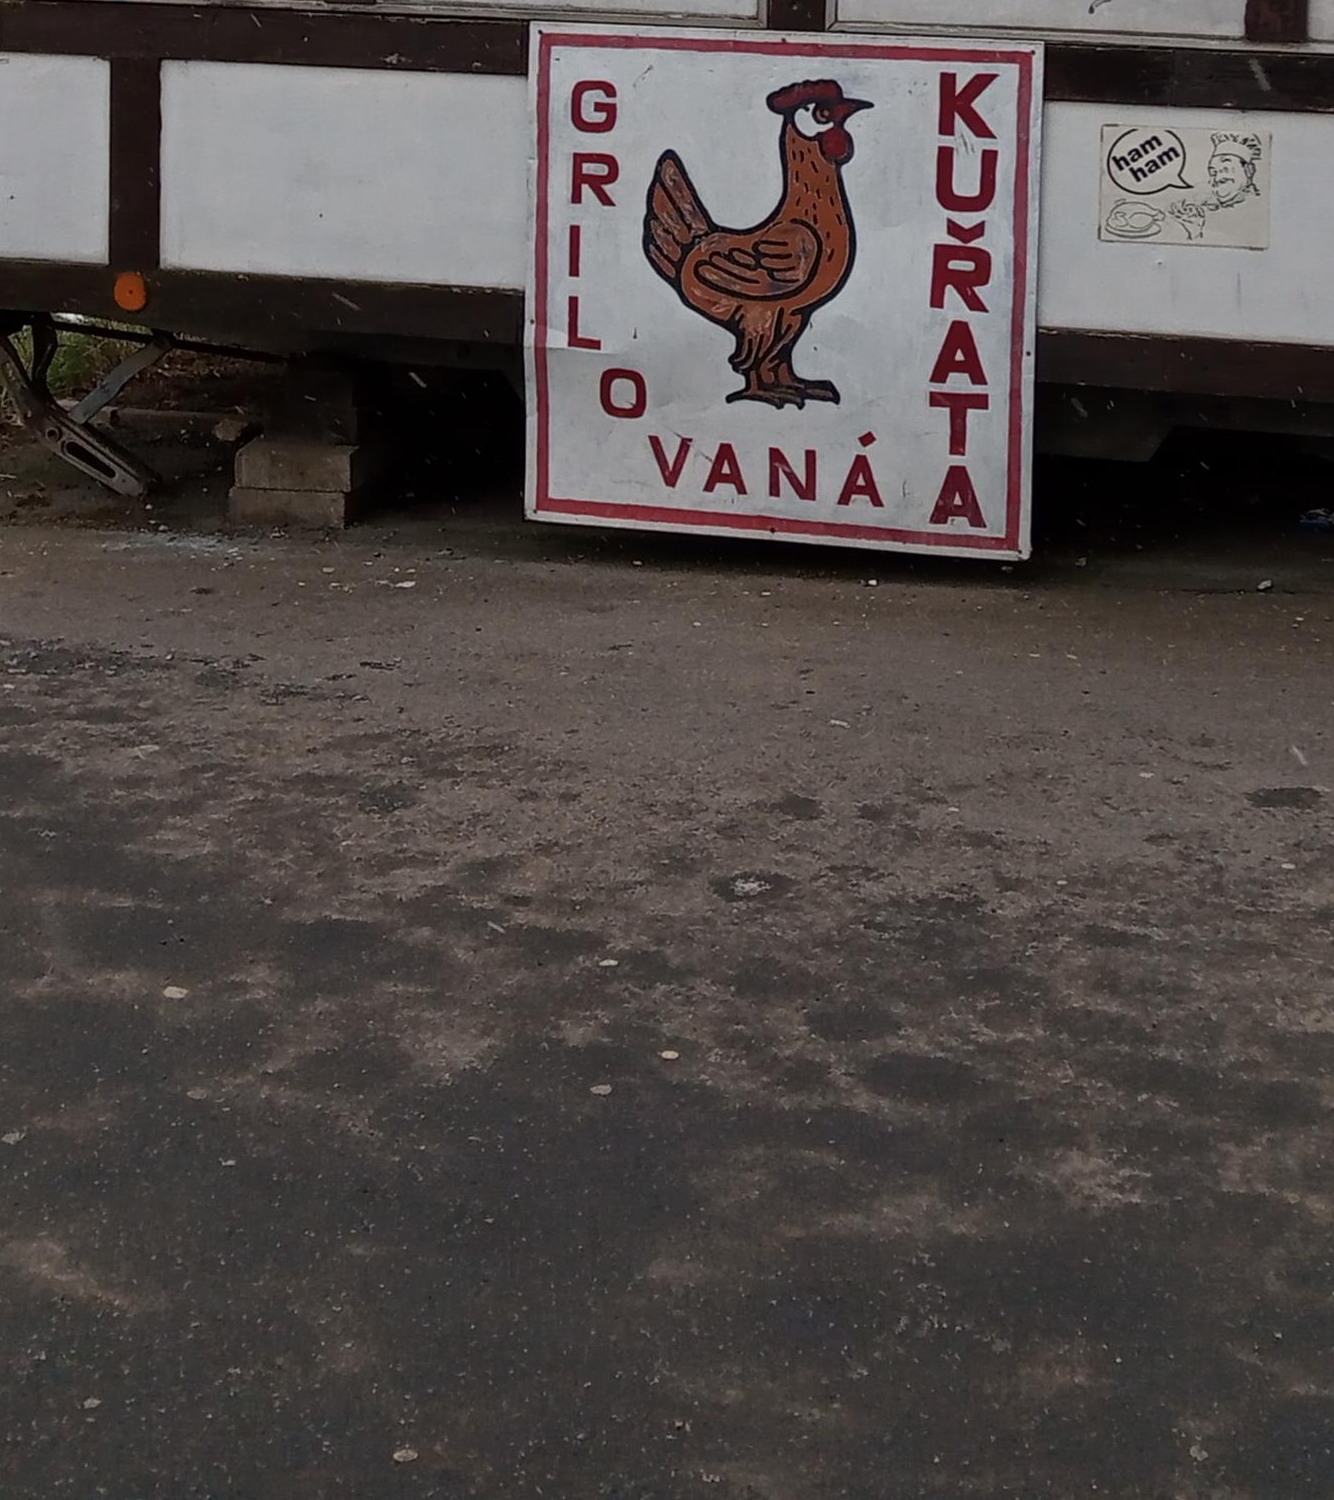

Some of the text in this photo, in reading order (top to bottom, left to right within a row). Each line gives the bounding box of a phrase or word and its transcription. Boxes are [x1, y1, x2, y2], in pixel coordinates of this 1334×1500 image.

[1111, 134, 1164, 172] ham
[1128, 146, 1182, 184] ham
[567, 79, 885, 508] GRILOVANÁ
[928, 71, 1000, 529] KUŘATA
